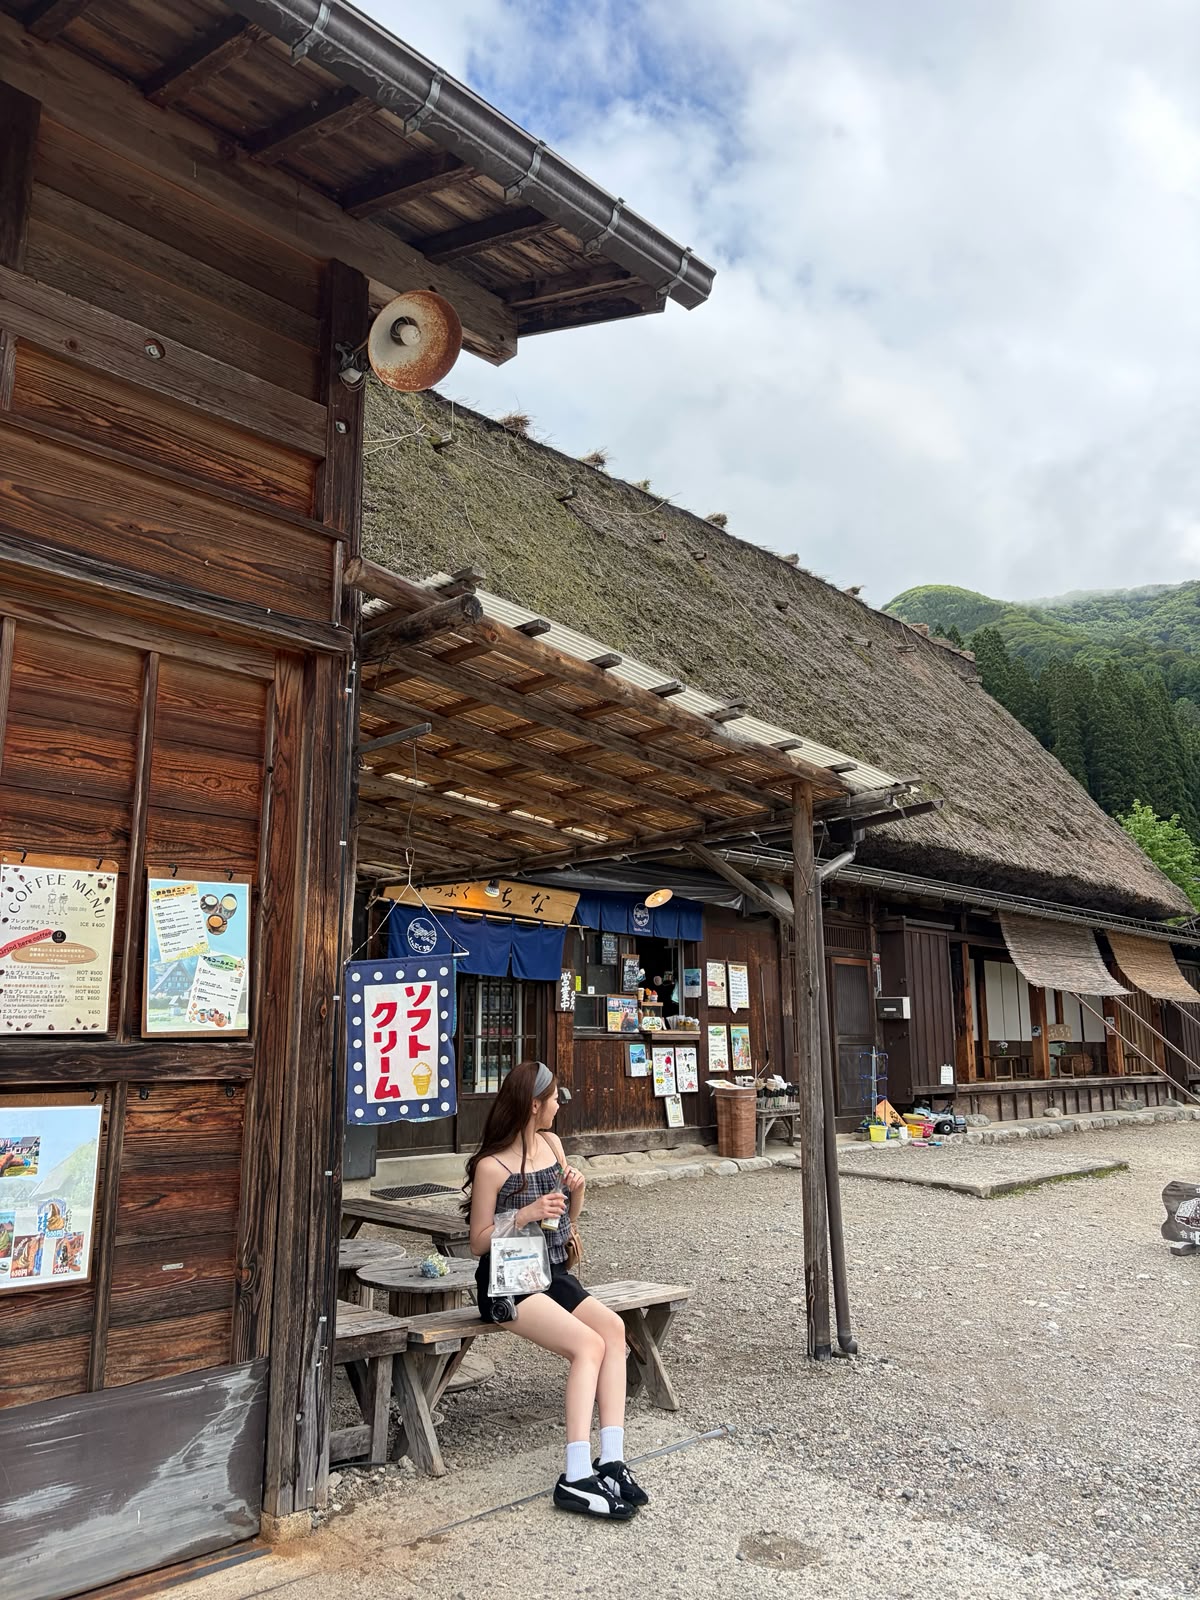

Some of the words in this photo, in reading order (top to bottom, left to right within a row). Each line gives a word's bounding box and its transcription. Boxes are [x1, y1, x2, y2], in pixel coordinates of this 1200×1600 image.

[8, 873, 67, 914] COFFEE
[72, 879, 106, 919] MENU
[17, 939, 33, 948] here
[32, 931, 52, 942] coffee
[560, 971, 572, 1012] 営業中
[404, 984, 432, 1059] ソフト
[371, 1002, 402, 1100] クリーム
